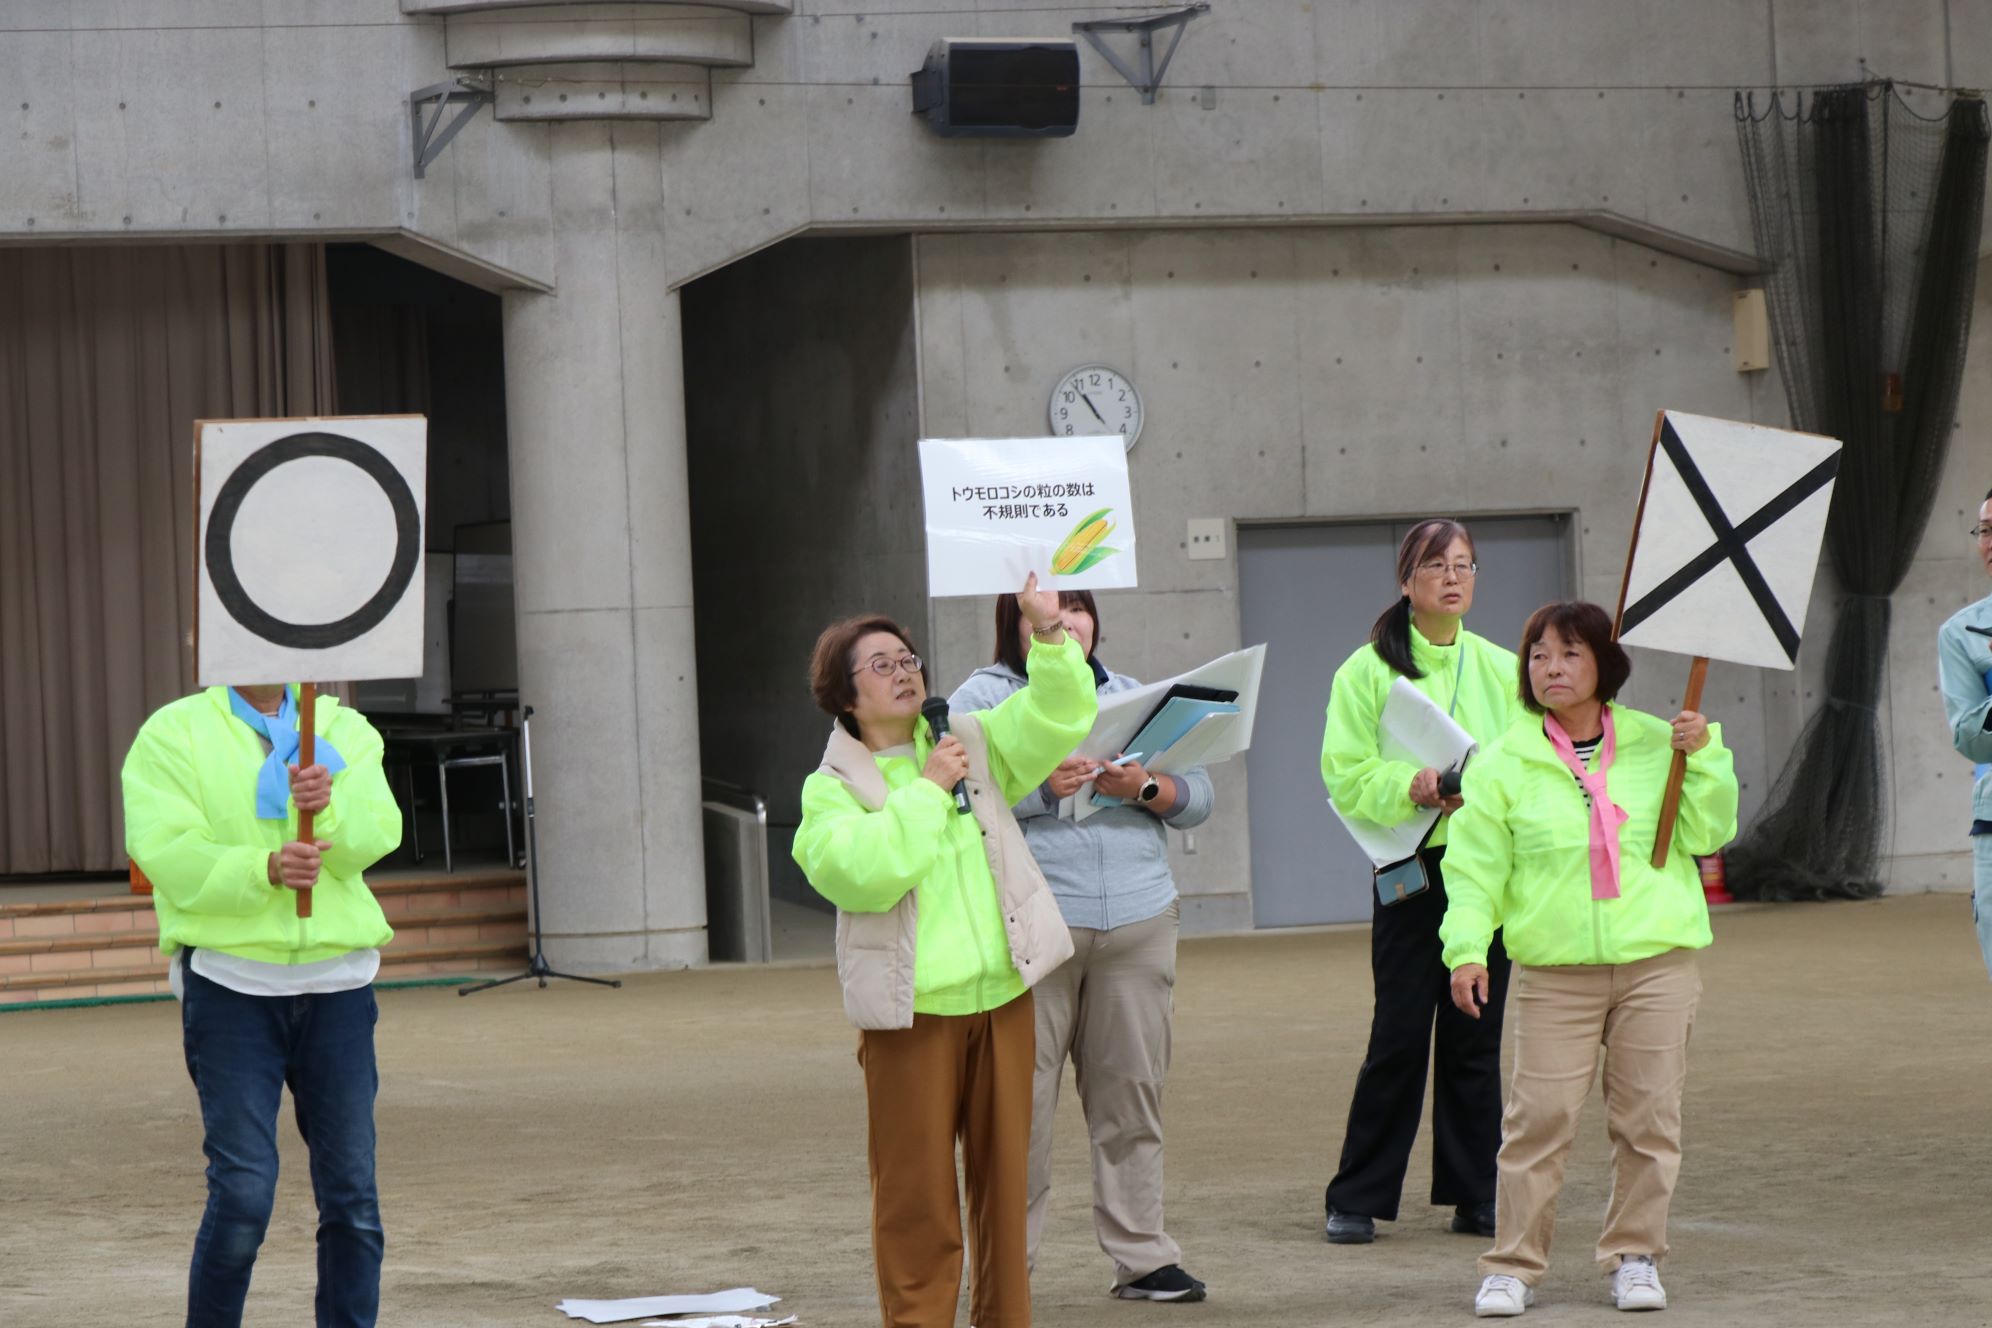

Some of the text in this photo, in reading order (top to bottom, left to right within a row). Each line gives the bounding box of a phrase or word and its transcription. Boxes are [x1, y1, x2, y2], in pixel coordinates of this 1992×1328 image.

[1075, 378, 1084, 390] 11
[1089, 374, 1101, 386] 12
[1108, 378, 1113, 390] 1
[1063, 391, 1075, 403] 10
[1118, 389, 1126, 401] 2
[1060, 408, 1068, 420] 9
[1124, 406, 1132, 418] 3
[1065, 424, 1073, 436] 8
[1119, 423, 1127, 435] 4
[951, 482, 1095, 501] トウモロコシの粒の数は
[983, 503, 1068, 520] 不規則である
